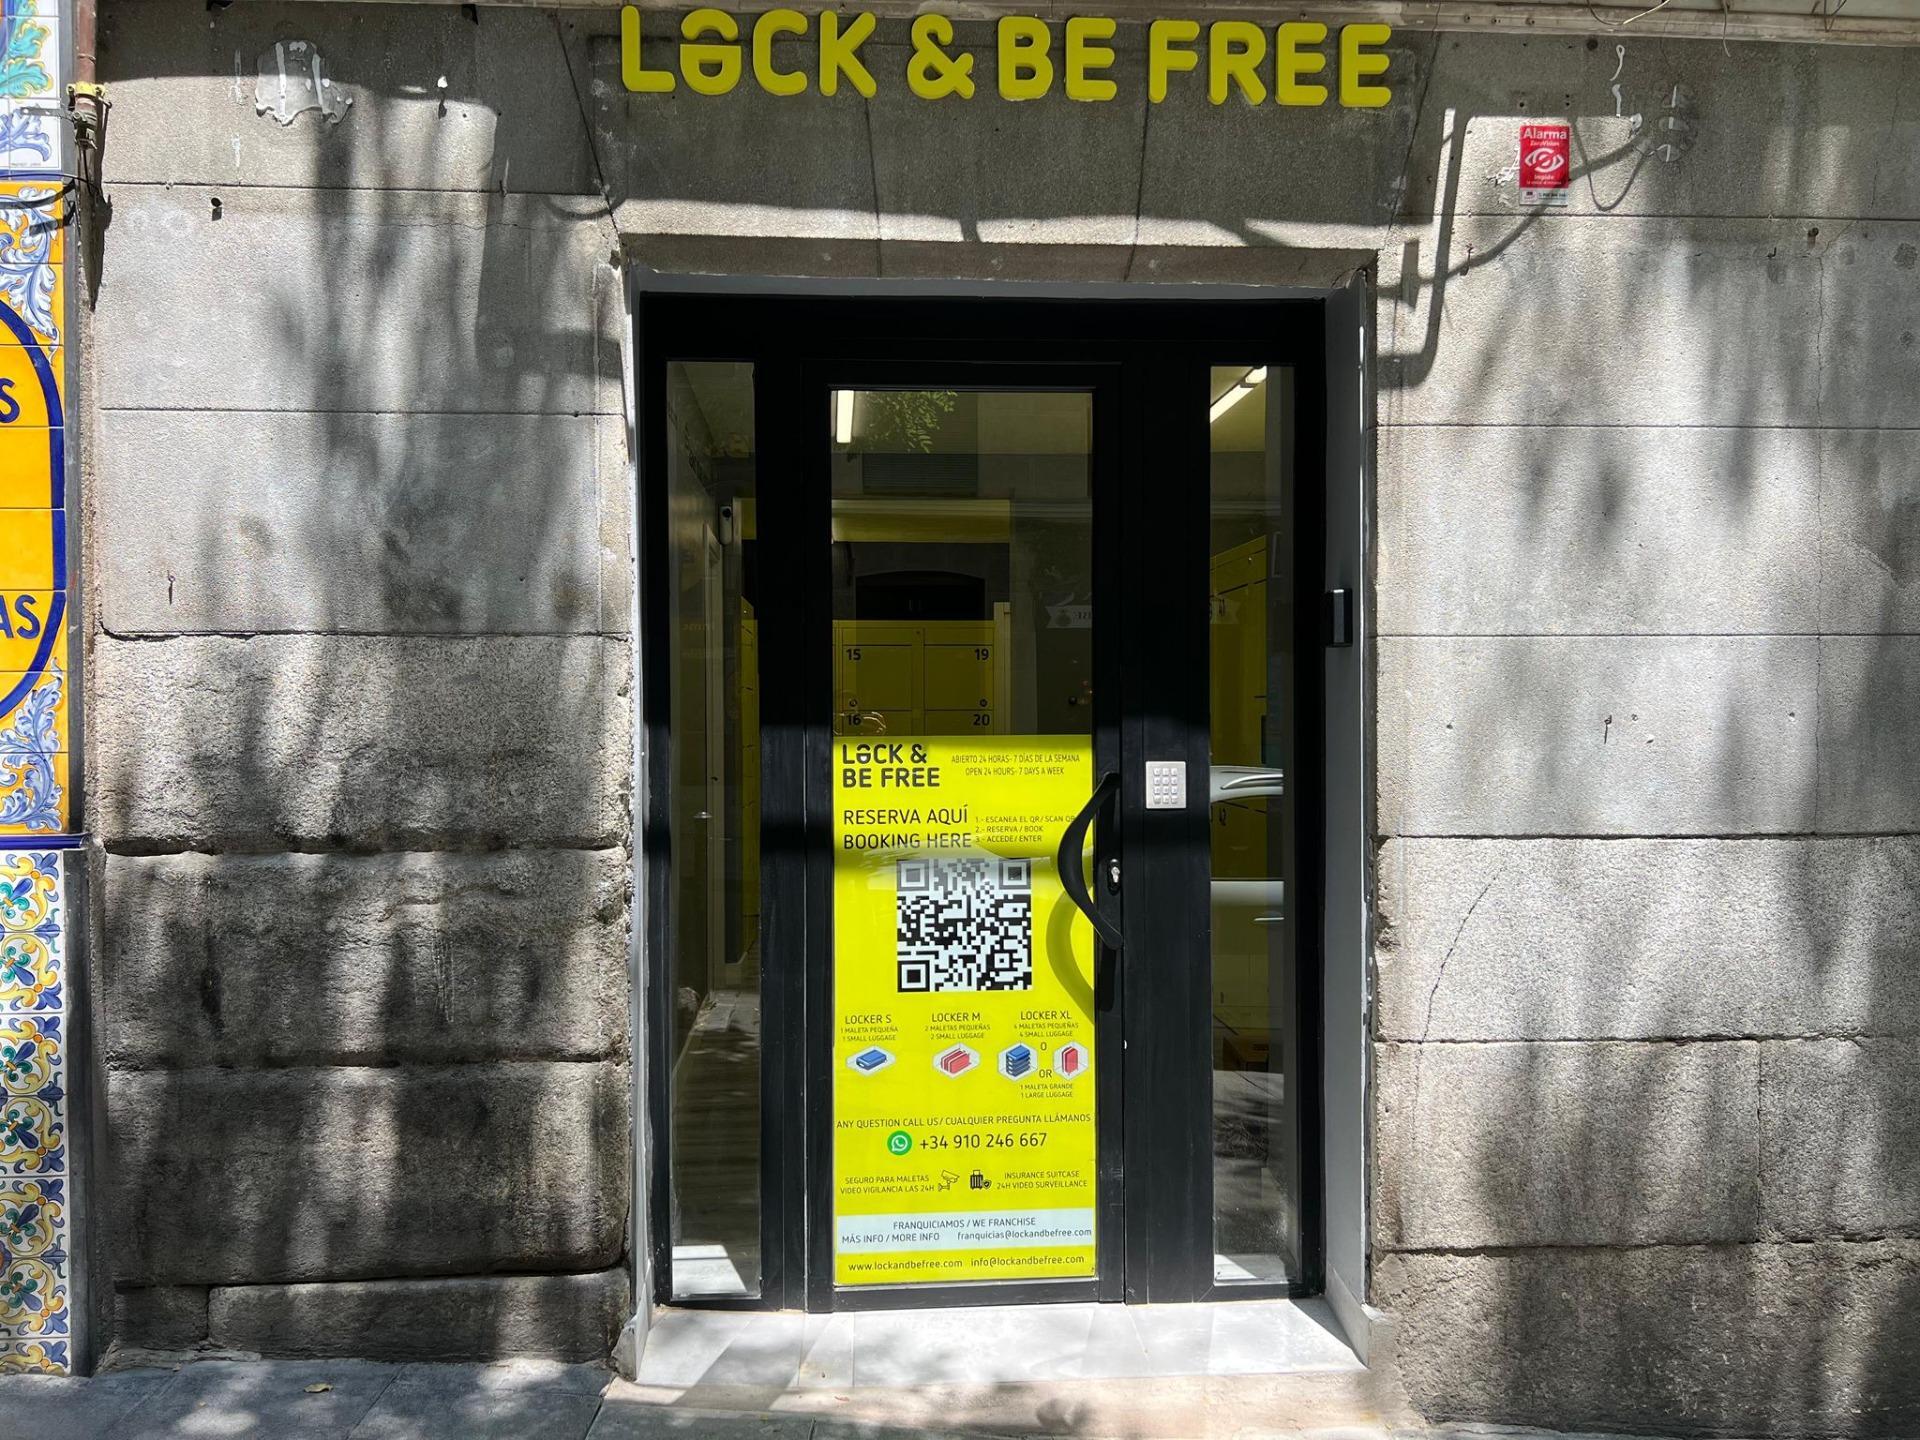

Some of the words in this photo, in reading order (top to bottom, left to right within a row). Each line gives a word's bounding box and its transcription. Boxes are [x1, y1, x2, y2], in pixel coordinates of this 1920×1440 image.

[621, 5, 877, 98] LOCK
[907, 14, 972, 100] &
[998, 16, 1117, 101] BE
[1148, 20, 1392, 107] FREE
[1523, 128, 1567, 140] Alarma
[846, 649, 861, 661] 15
[975, 649, 989, 661] 19
[846, 714, 861, 726] 16
[973, 714, 990, 726] 20
[842, 743, 904, 764] LOCK
[910, 743, 927, 764] &
[952, 755, 978, 763] ABIERTO
[980, 754, 987, 763] 24
[1019, 753, 1033, 763] DÍAS
[1035, 754, 1043, 762] DE
[1045, 754, 1053, 762] LA
[1054, 753, 1081, 762] SEMANA
[965, 767, 982, 775] OPEN
[984, 767, 992, 775] 24
[1024, 767, 1040, 775] DAYS
[1047, 767, 1065, 775] WEEK
[842, 767, 872, 788] BE
[880, 767, 940, 787] FREE
[844, 809, 921, 825] RESERVA
[926, 804, 968, 825] AQUÍ
[986, 825, 1018, 833] RESERVA
[844, 833, 920, 849] BOOKING
[927, 833, 972, 848] HERE
[844, 1015, 883, 1025] LOCKER
[885, 1014, 892, 1024] S
[931, 1013, 969, 1022] LOCKER
[972, 1012, 981, 1021] M
[1020, 1011, 1057, 1020] LOCKER
[1059, 1010, 1072, 1020] XL
[844, 1026, 868, 1034] MALETA
[869, 1025, 899, 1034] PEQUEÑA
[958, 1023, 991, 1032] PEQUEÑAS
[1019, 1022, 1046, 1030] MALETAS
[1047, 1021, 1079, 1030] PEQUEÑAS
[868, 1034, 896, 1042] LUGGAGE
[957, 1032, 985, 1040] LUGGAGE
[1046, 1030, 1073, 1038] LUGGAGE
[1038, 1068, 1053, 1079] OR
[1024, 1083, 1048, 1091] MALETA
[1049, 1082, 1073, 1090] GRANDE
[1025, 1091, 1045, 1099] LARGE
[836, 1120, 854, 1129] ANY
[856, 1118, 901, 1129] QUESTION
[903, 1117, 923, 1127] CALL
[945, 1116, 994, 1126] CUALQUIER
[996, 1114, 1042, 1124] PREGUNTA
[1044, 1112, 1091, 1123] LLÁMANOS
[919, 1136, 948, 1150] +34
[953, 1135, 980, 1149] 910
[986, 1134, 1014, 1147] 246
[1019, 1132, 1047, 1147] 667
[845, 1176, 875, 1184] SEGURO
[876, 1175, 895, 1183] PARA
[896, 1174, 930, 1182] MALETAS
[1004, 1171, 1045, 1179] INSURANCE
[1046, 1170, 1080, 1178] SUITCASE
[840, 1186, 862, 1194] VIDEO
[863, 1184, 903, 1194] VIGILANCIA
[904, 1184, 919, 1193] LAS
[920, 1184, 934, 1192] 24H
[1012, 1181, 1034, 1189] VIDEO
[1035, 1179, 1088, 1188] SURVEILLANCE
[893, 1219, 965, 1230] FRANQUICIAMOS
[972, 1218, 986, 1227] WE
[988, 1217, 1036, 1226] FRANCHISE
[842, 1232, 861, 1243] MÁS
[863, 1233, 884, 1243] INFO
[892, 1233, 917, 1242] MORE
[919, 1232, 940, 1241] INFO
[957, 1228, 1092, 1241] franquicias@lockandbefree.com
[848, 1259, 963, 1271] www.lockandbefree.com
[970, 1255, 1085, 1267] info@lockandbefree.com
